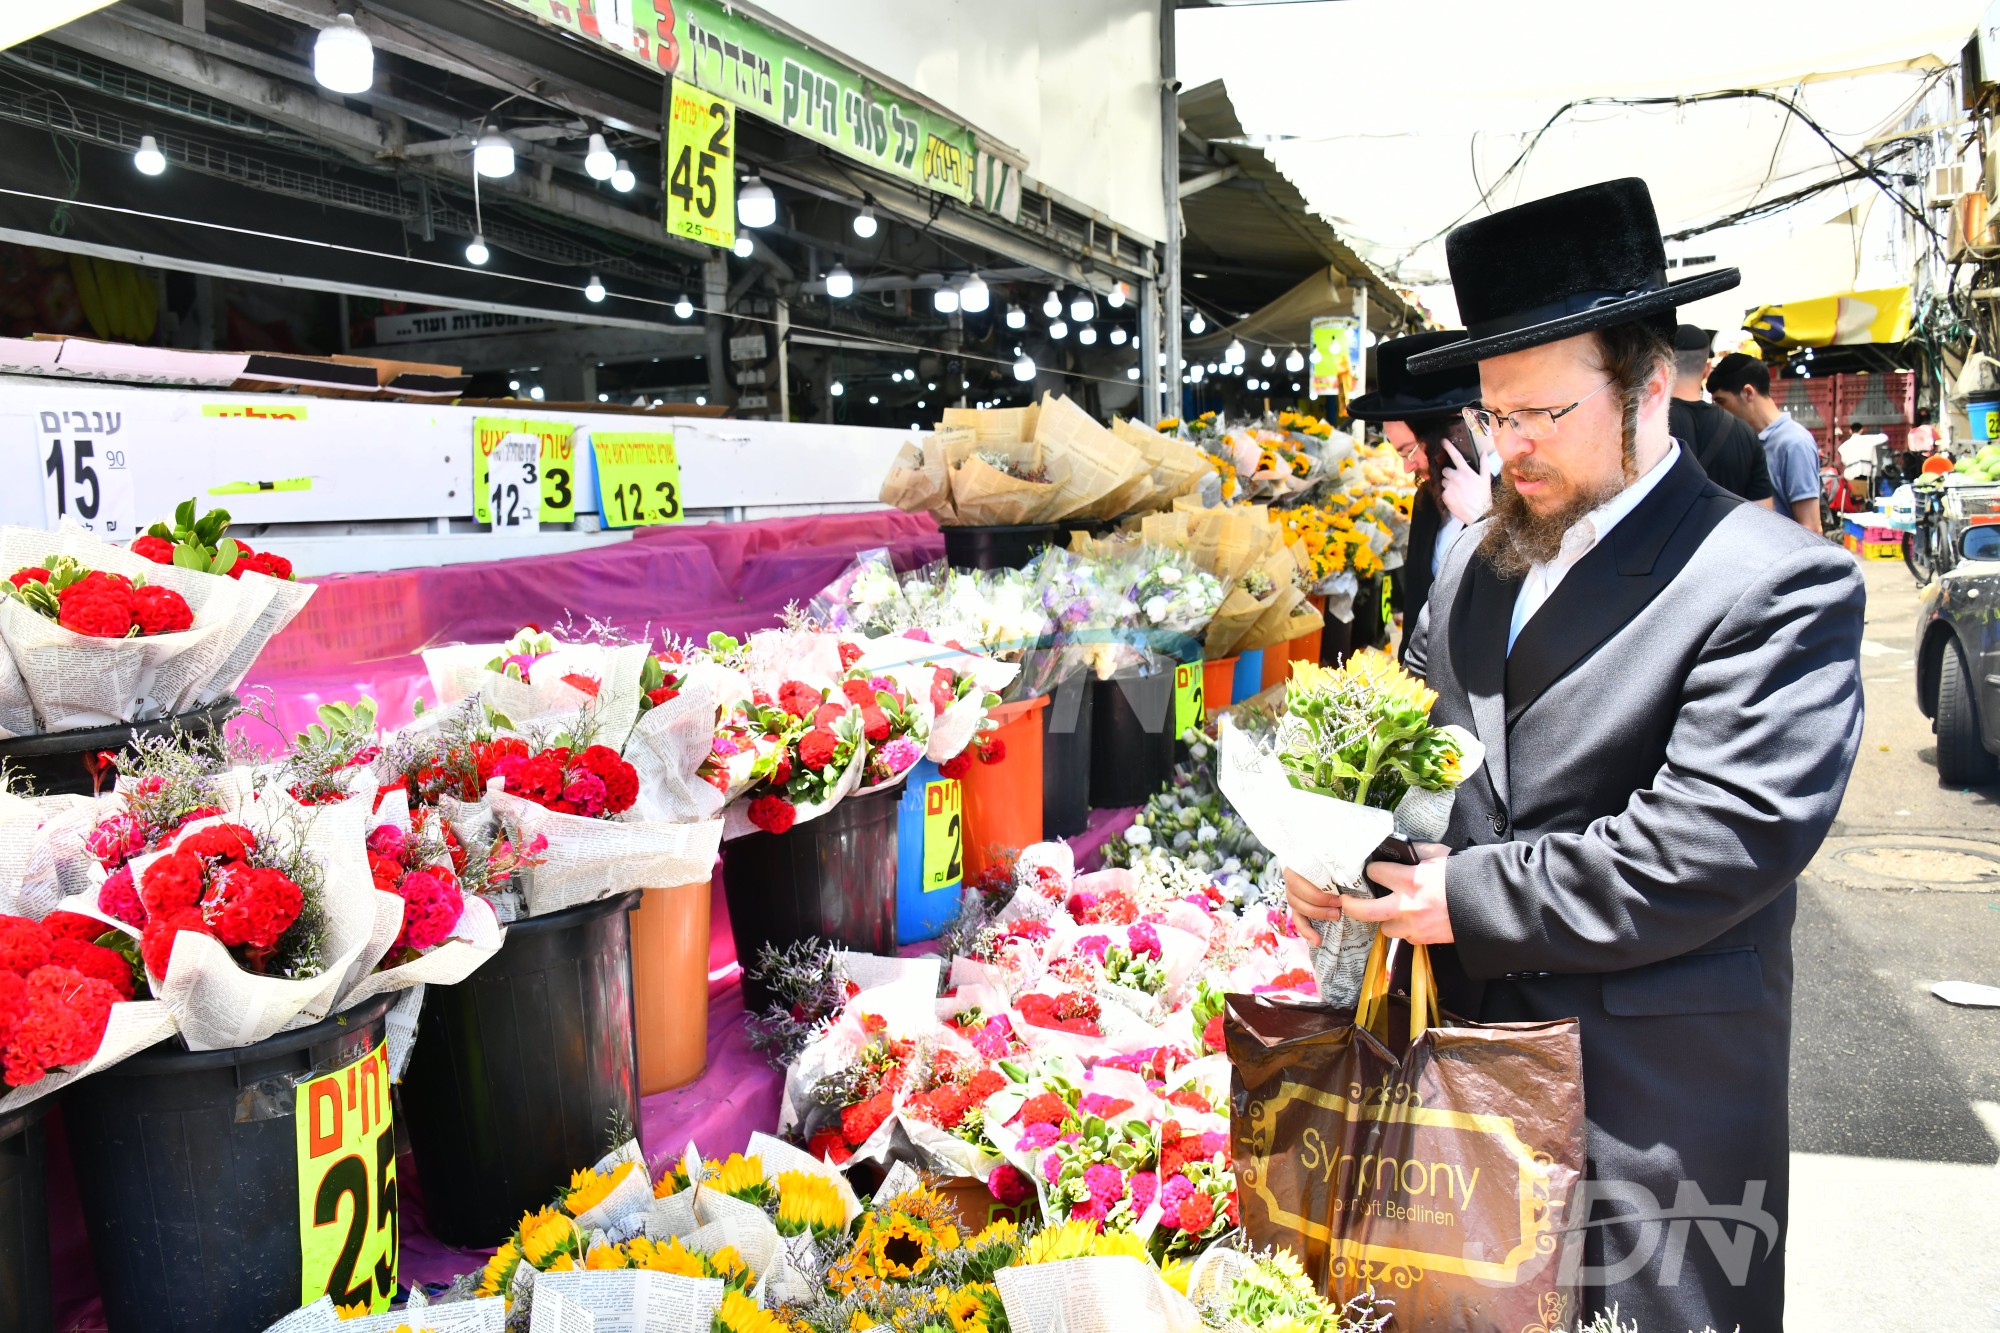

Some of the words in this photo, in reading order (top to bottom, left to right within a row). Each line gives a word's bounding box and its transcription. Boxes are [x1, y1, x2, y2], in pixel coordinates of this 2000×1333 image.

[689, 23, 772, 106] מהדרין
[783, 57, 839, 137] הירק
[708, 102, 731, 158] 2
[844, 88, 888, 157] סוגי
[891, 104, 919, 171] כל
[670, 145, 717, 219] 45
[686, 221, 702, 236] 25
[40, 411, 121, 435] ענבים
[46, 439, 100, 520] 15
[106, 450, 125, 468] 90
[522, 463, 538, 484] 3
[544, 468, 572, 509] 3
[491, 484, 520, 526] 12
[614, 483, 645, 521] 12
[655, 481, 679, 518] 3
[314, 1122, 397, 1308] 25
[1386, 1200, 1454, 1226] Bedlinen
